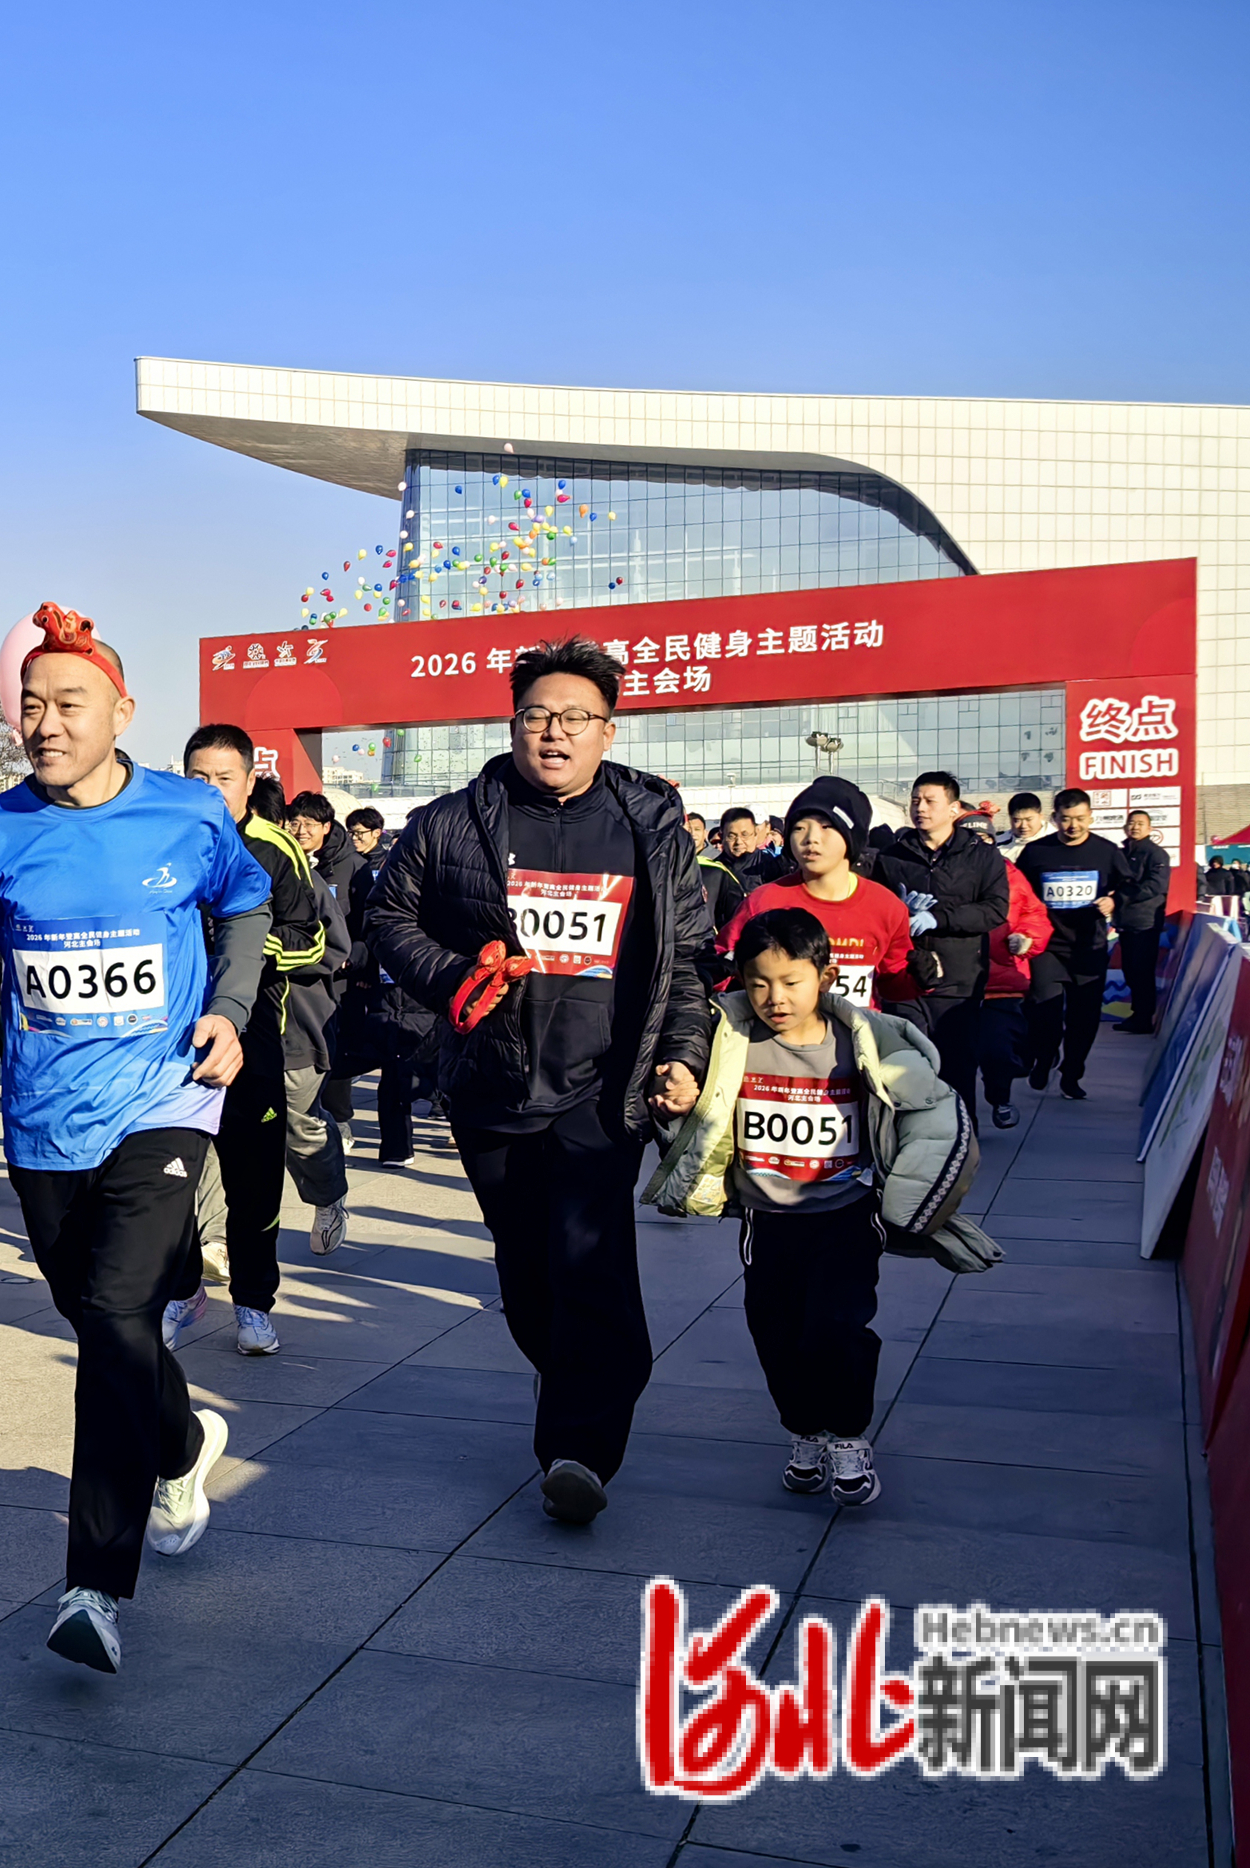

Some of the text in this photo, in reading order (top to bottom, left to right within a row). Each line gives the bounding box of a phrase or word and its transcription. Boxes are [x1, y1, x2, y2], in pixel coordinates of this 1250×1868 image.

[410, 619, 884, 679] 2026 年高全民健身主题活动
[616, 664, 712, 697] 主会场
[1082, 697, 1177, 742] 终点
[1082, 750, 1176, 779] FINISH
[1046, 885, 1093, 897] A0320
[26, 959, 156, 999] A0366
[744, 1111, 853, 1146] B0051
[834, 1442, 854, 1451] FILA
